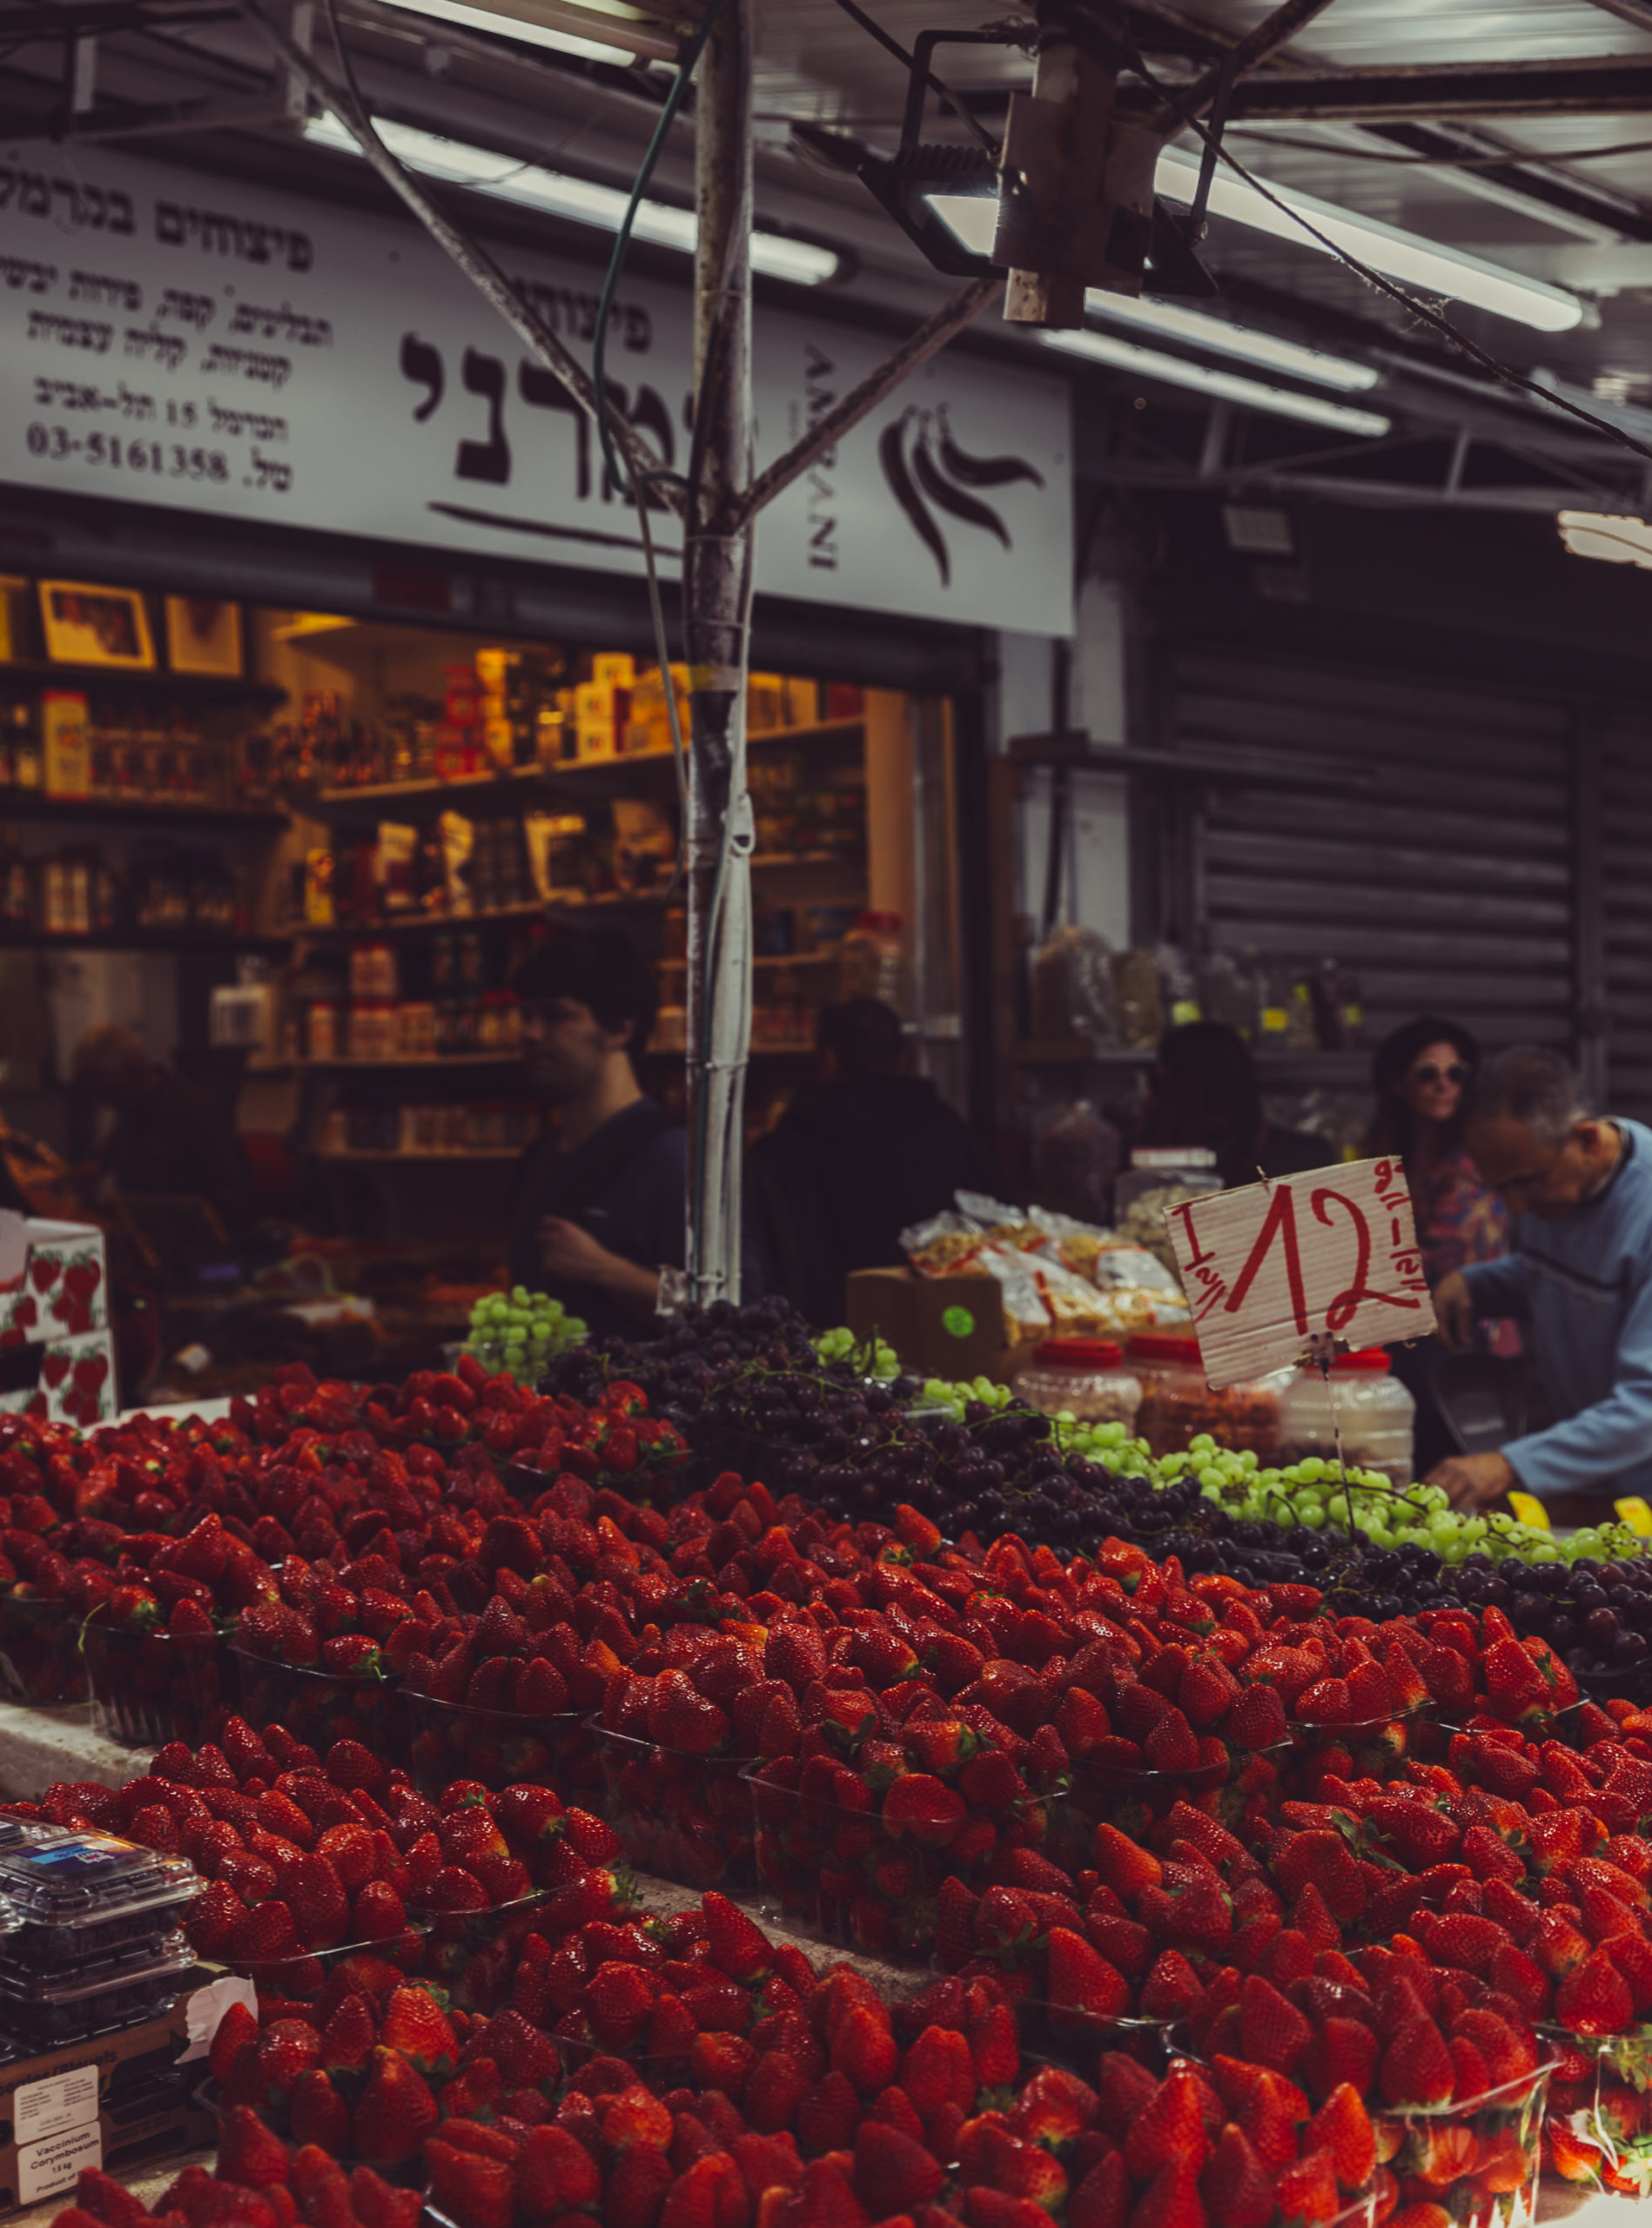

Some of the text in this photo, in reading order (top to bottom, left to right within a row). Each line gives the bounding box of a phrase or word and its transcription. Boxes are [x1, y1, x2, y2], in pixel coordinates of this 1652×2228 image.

[155, 199, 314, 273] פיצוחים
[165, 398, 198, 430] 15
[206, 396, 290, 442] הכרמל
[400, 331, 759, 513] מרני
[25, 421, 231, 485] 03-5161358
[1224, 1184, 1421, 1337] 12
[30, 2138, 100, 2171] Corymbosum
[36, 2131, 91, 2157] Vaccinium
[36, 2176, 67, 2193] Product
